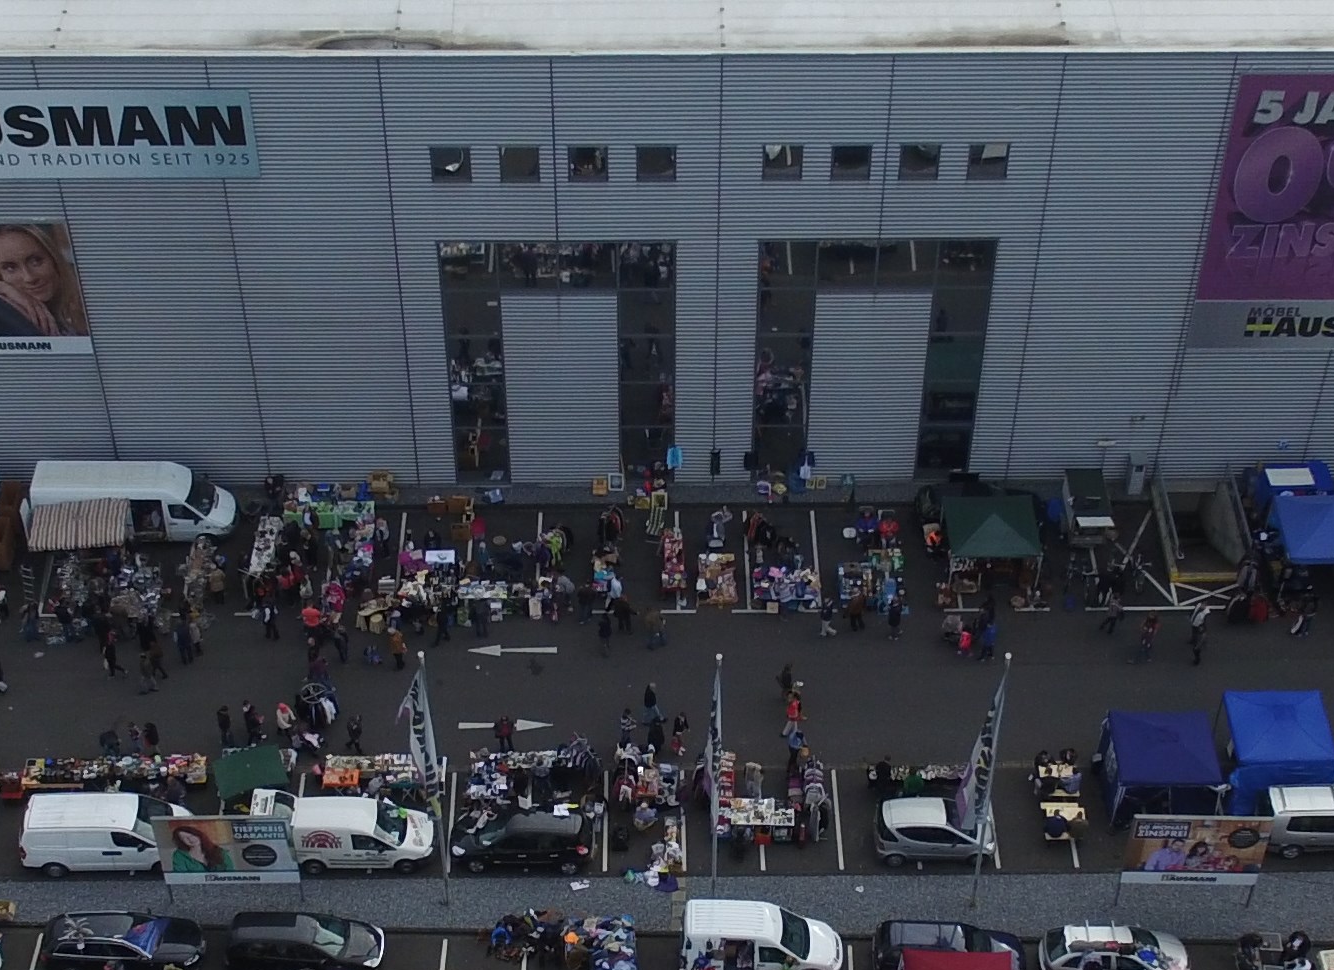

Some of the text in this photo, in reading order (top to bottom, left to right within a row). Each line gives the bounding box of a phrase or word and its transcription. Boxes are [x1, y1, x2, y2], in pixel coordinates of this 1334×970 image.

[1256, 91, 1285, 125] 5
[30, 153, 142, 167] TRADITION
[152, 152, 193, 167] SEIT
[203, 152, 251, 167] 1925
[1248, 304, 1301, 317] MÖBEL
[1137, 829, 1188, 838] ZINSFREI
